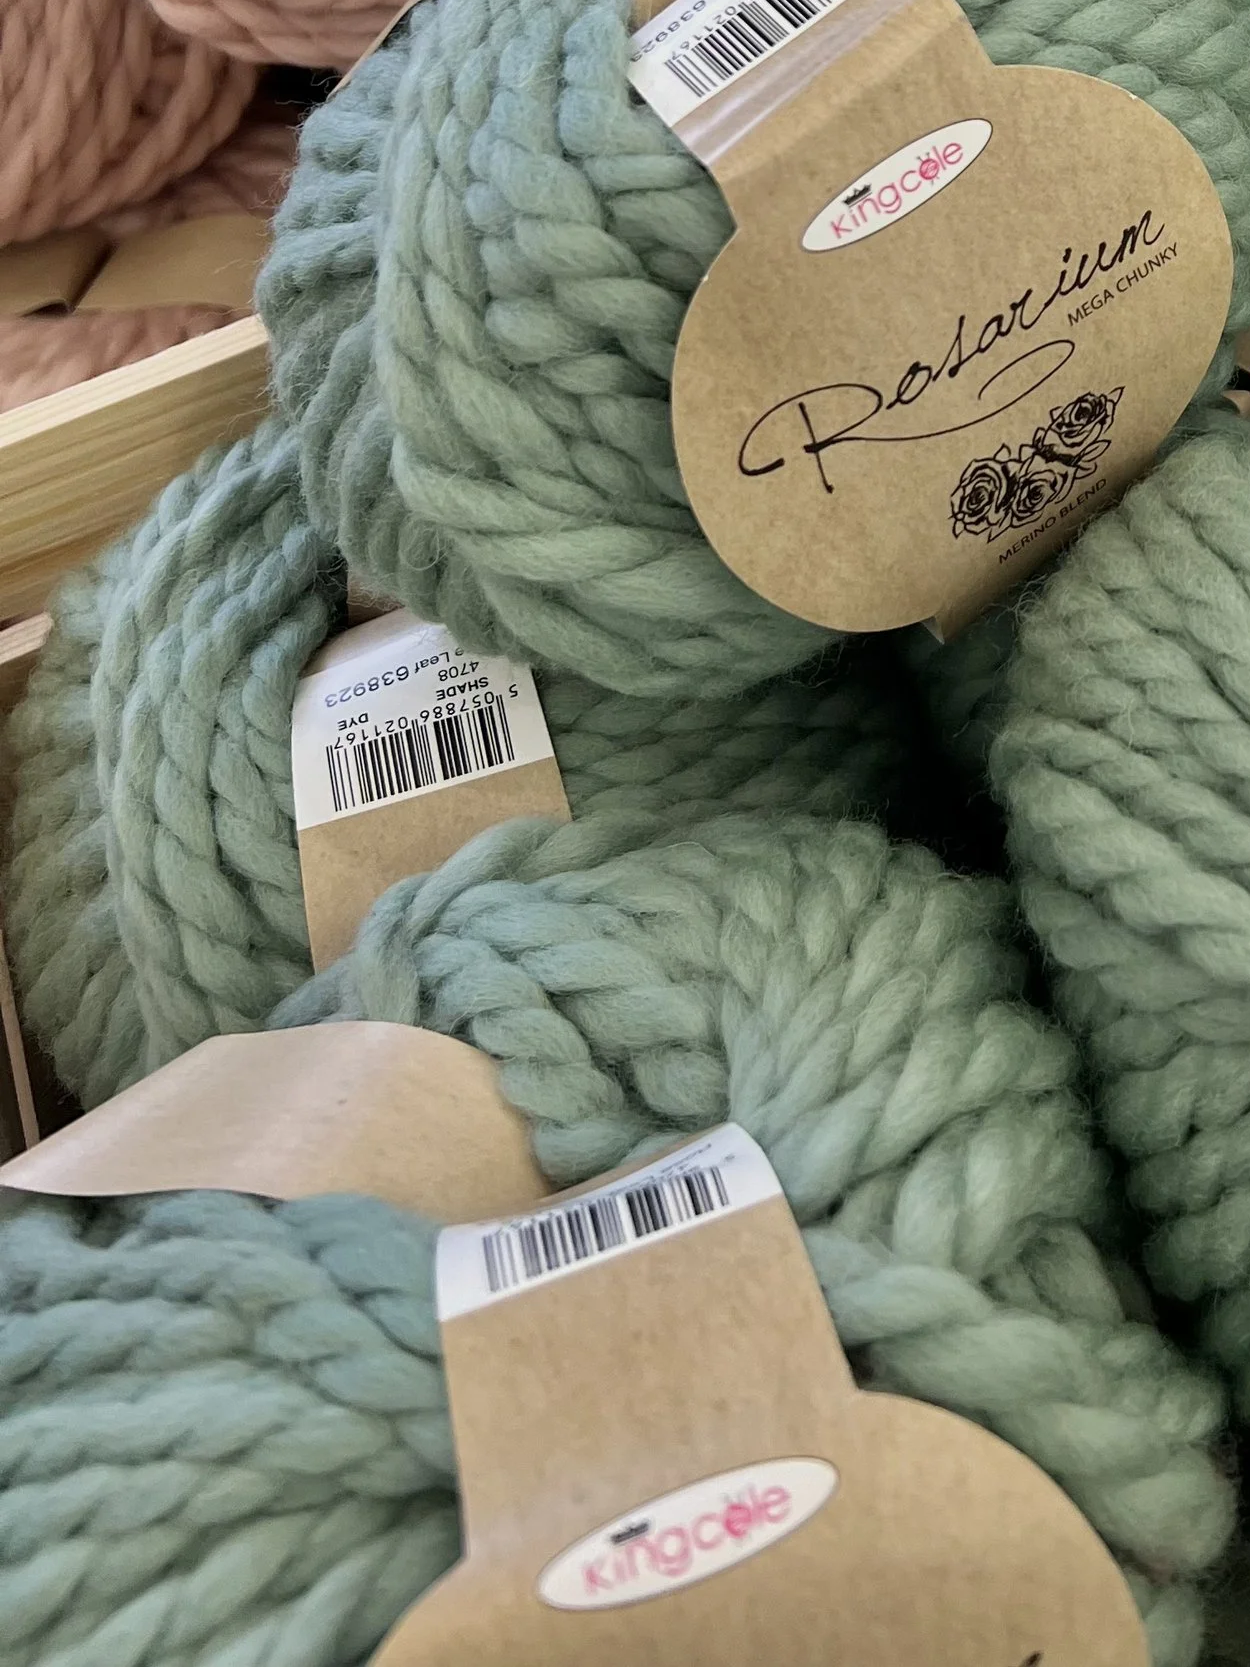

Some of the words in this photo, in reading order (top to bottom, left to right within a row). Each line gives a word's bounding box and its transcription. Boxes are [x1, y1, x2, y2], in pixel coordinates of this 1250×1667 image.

[631, 0, 707, 63] 638923
[672, 5, 737, 61] 021167
[1067, 290, 1115, 328] MEGA
[1115, 242, 1180, 293] CHUNKY
[739, 210, 1165, 494] Rosarium
[998, 516, 1056, 564] MERINO
[1059, 478, 1107, 518] BLEND
[414, 650, 450, 675] Leaf
[438, 660, 480, 681] 4708
[324, 665, 409, 708] 638923
[436, 676, 489, 701] SHADE
[508, 683, 519, 698] 5
[337, 712, 370, 731] DYE
[419, 691, 495, 722] 057886
[334, 716, 408, 750] 021167
